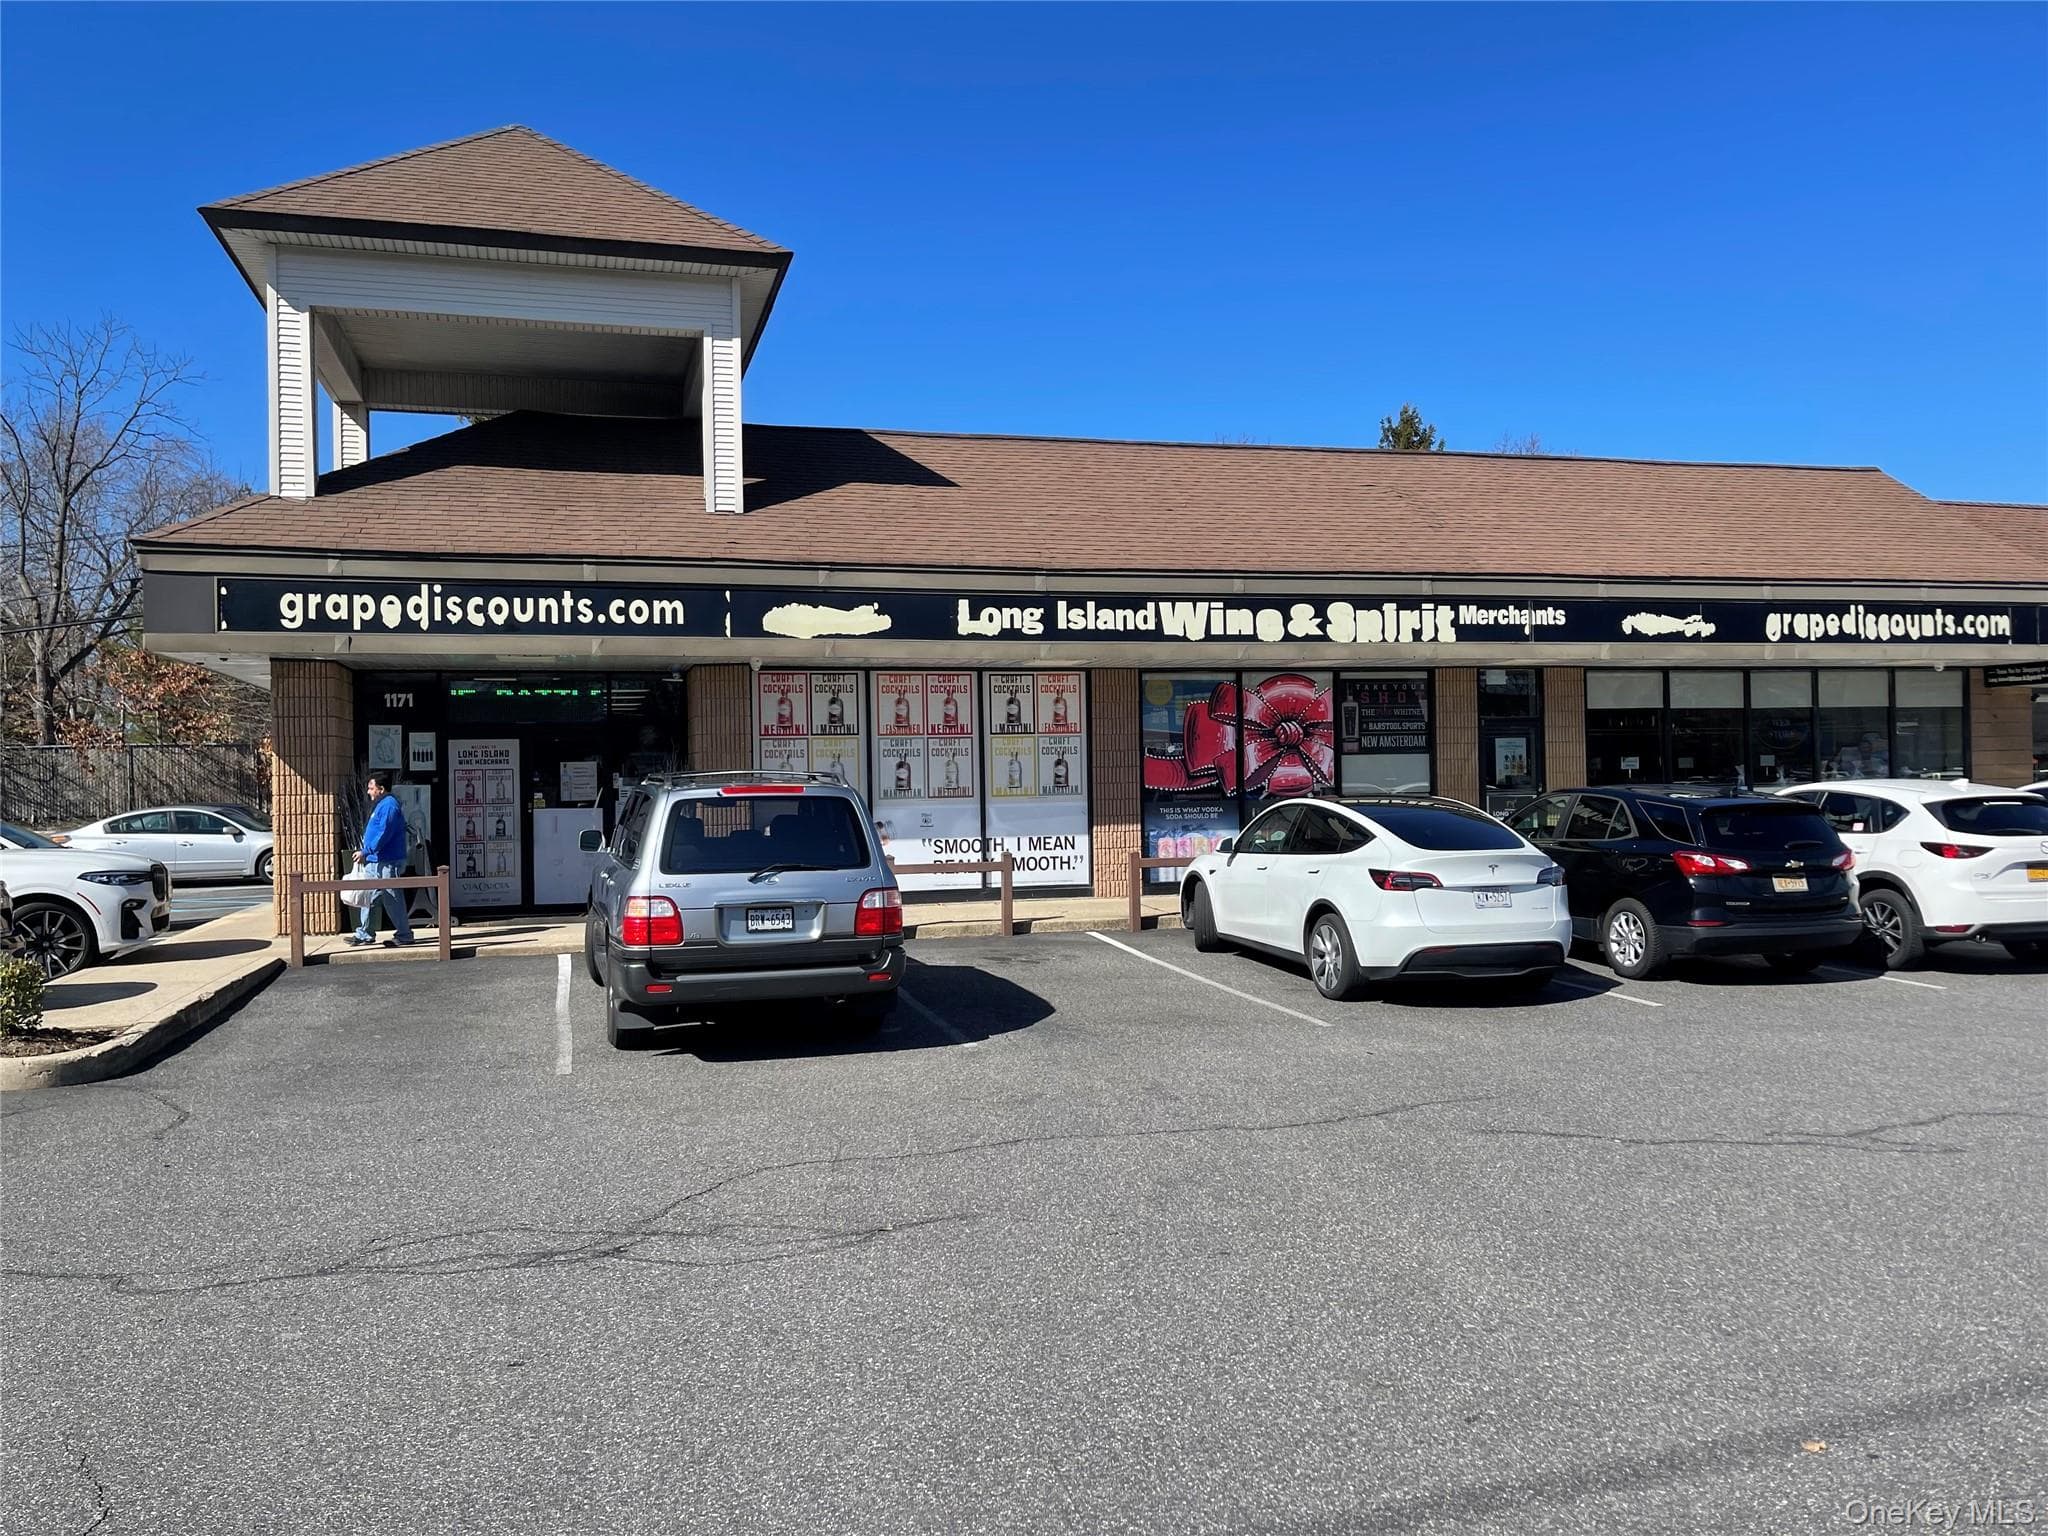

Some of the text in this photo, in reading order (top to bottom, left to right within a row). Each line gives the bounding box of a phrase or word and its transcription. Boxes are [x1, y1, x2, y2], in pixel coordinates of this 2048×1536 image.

[279, 583, 685, 631] grapediscounts.com
[957, 598, 1044, 637] Long
[1057, 600, 1156, 632] Island
[1459, 604, 1566, 629] Merchants
[1765, 604, 2010, 641] grapediscounts.com
[763, 684, 804, 694] COCKTAILS
[814, 684, 854, 694] COCKTAILS
[881, 685, 920, 694] COCKTAILS
[930, 685, 968, 694] COCKTAILS
[993, 685, 1031, 694] COCKTAILS
[1040, 685, 1077, 694] COCKTAILS
[384, 693, 413, 707] 1171
[1361, 708, 1376, 716] THE
[1402, 722, 1426, 730] SPORTS
[1361, 735, 1426, 748] NEW AMSTERDAM
[457, 749, 510, 758] LONG ISLAND
[1017, 836, 1021, 851] I
[1028, 835, 1076, 851] MEAN
[1010, 854, 1085, 872] MOOTH."
[750, 913, 791, 927] BRW-6543
